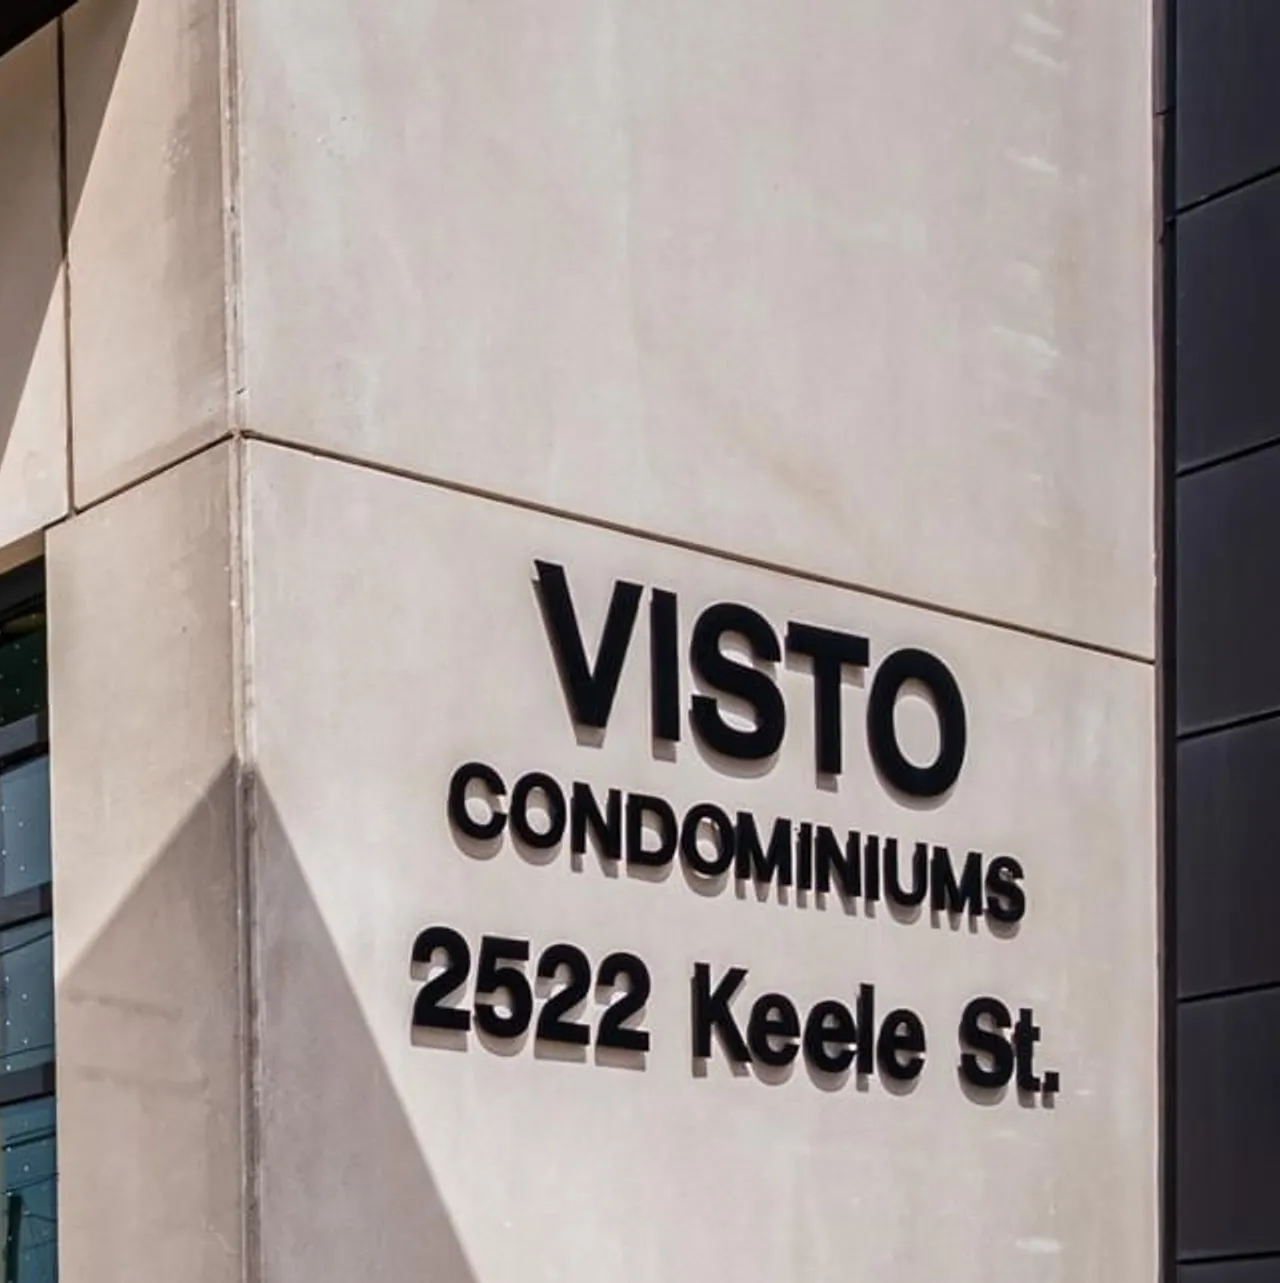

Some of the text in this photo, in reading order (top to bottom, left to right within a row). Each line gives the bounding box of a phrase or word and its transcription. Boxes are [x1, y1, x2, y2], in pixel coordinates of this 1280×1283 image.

[533, 559, 967, 797] VISTO
[447, 762, 1026, 924] CONDOMINIUMS
[410, 926, 1059, 1093] 2522 Keele St.
